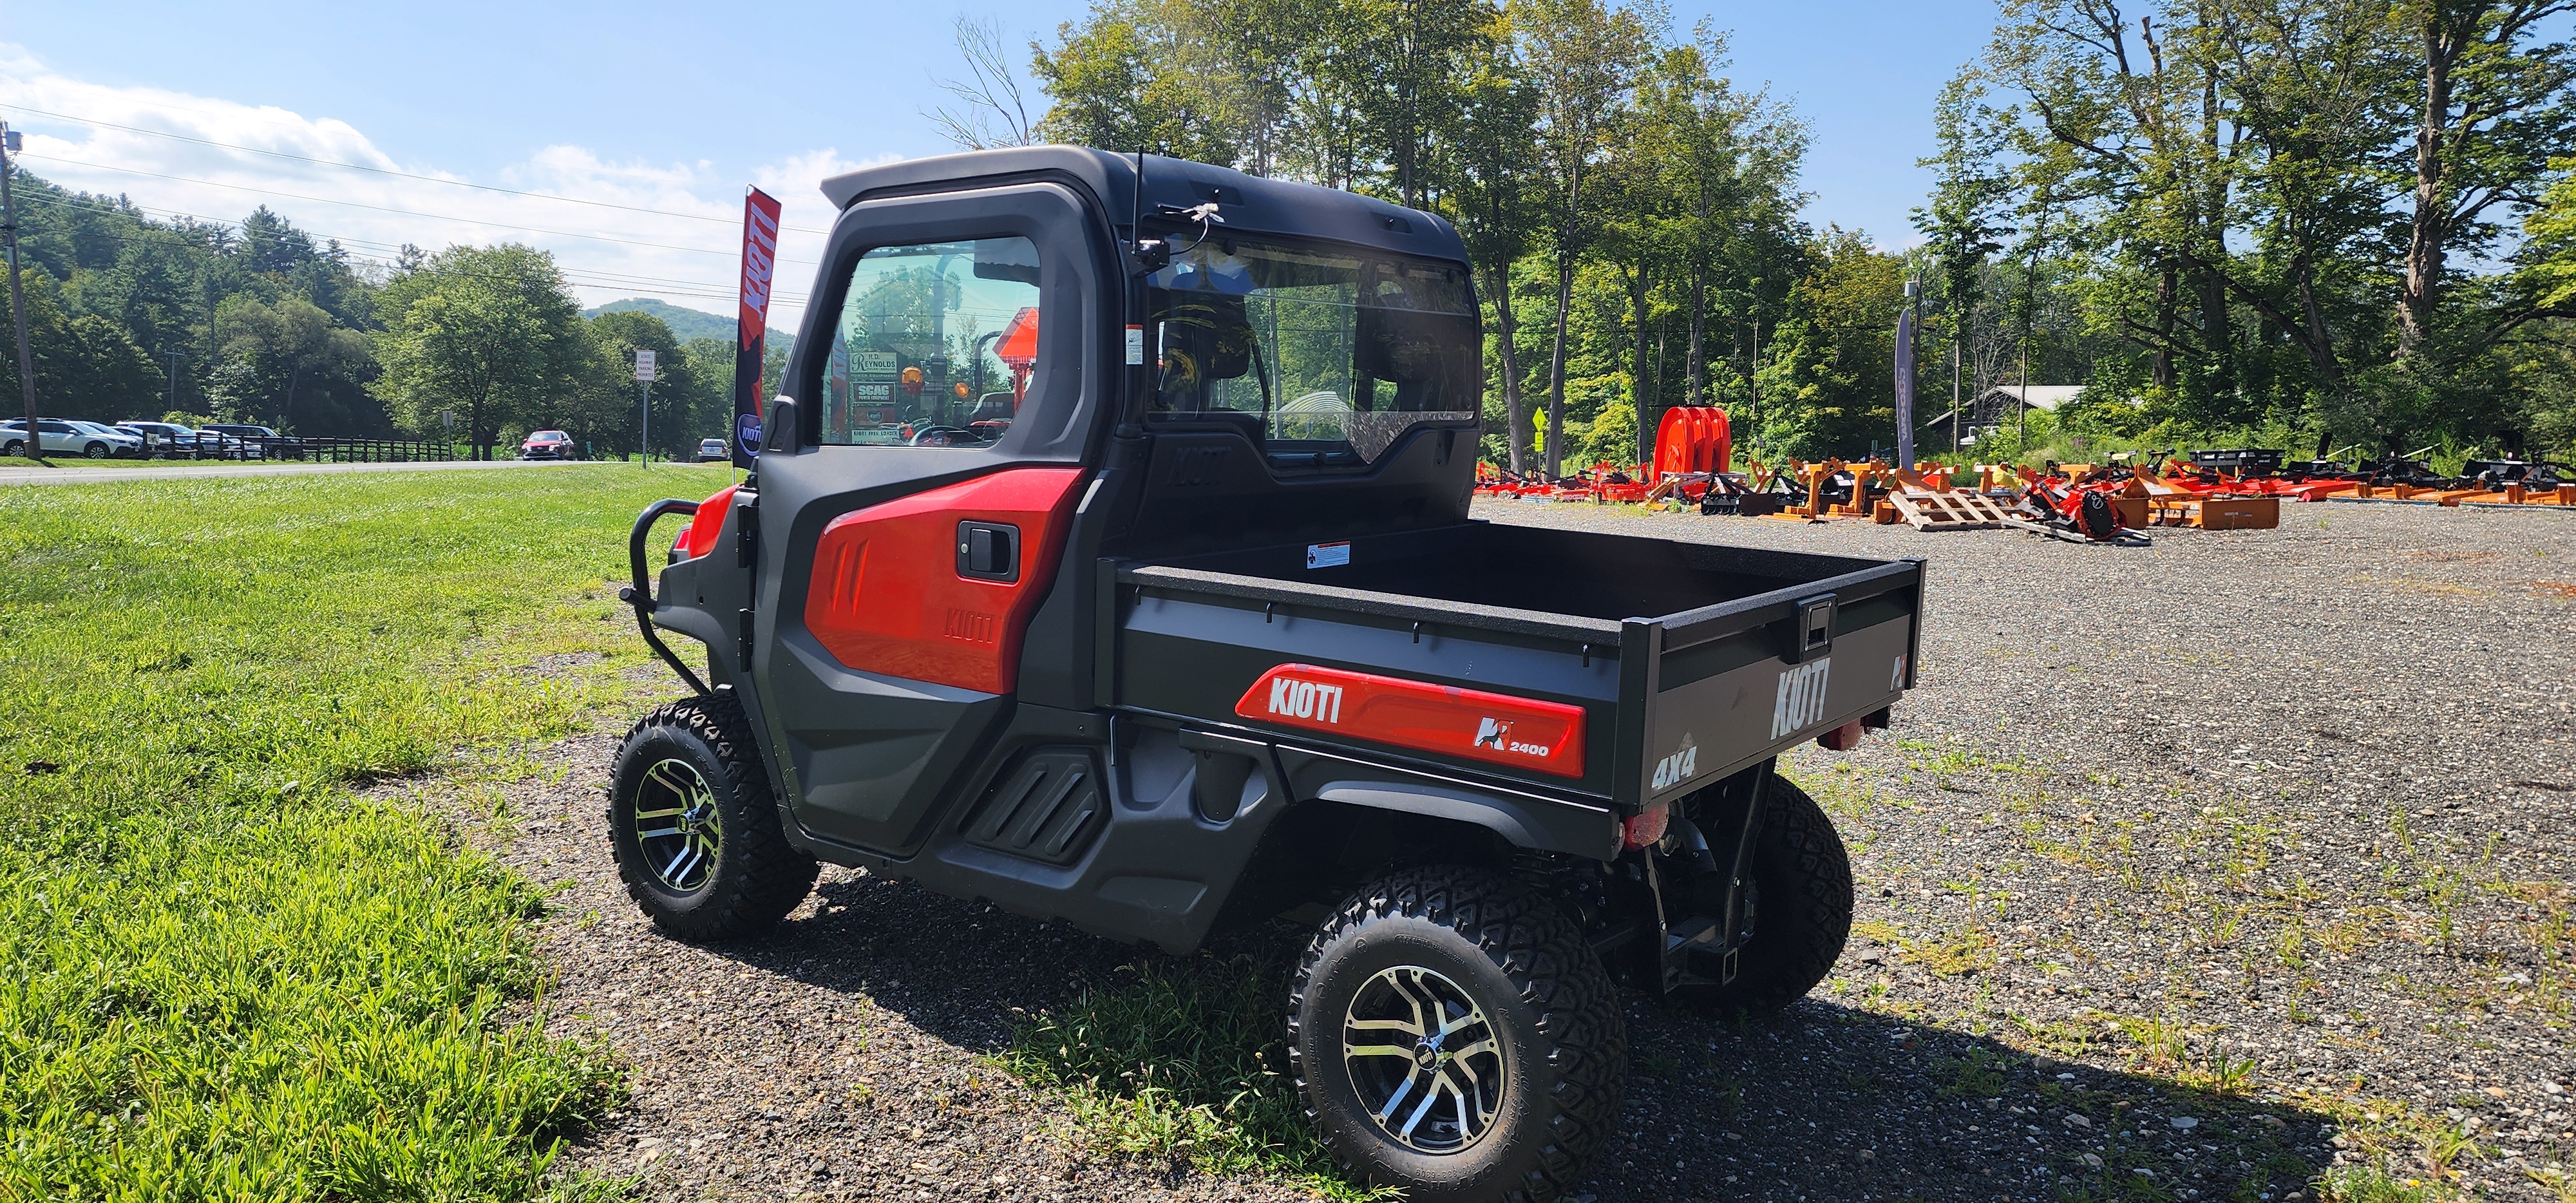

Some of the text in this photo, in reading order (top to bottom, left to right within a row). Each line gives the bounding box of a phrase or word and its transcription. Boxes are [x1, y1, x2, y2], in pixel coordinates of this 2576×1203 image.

[744, 202, 779, 321] KIOTI
[852, 353, 896, 372] REYNOLDS
[858, 385, 889, 395] SCAG
[742, 426, 761, 442] KIOTI
[1166, 446, 1231, 486] KIOTI
[944, 609, 995, 644] KIOTI
[1269, 677, 1343, 723] KIOTI
[1770, 657, 1831, 741] KIOTI
[1510, 741, 1549, 757] 2400
[1651, 746, 1697, 790] 4X4
[1418, 1051, 1434, 1065] KIOTI
[1499, 1096, 1519, 1139] SERVICE
